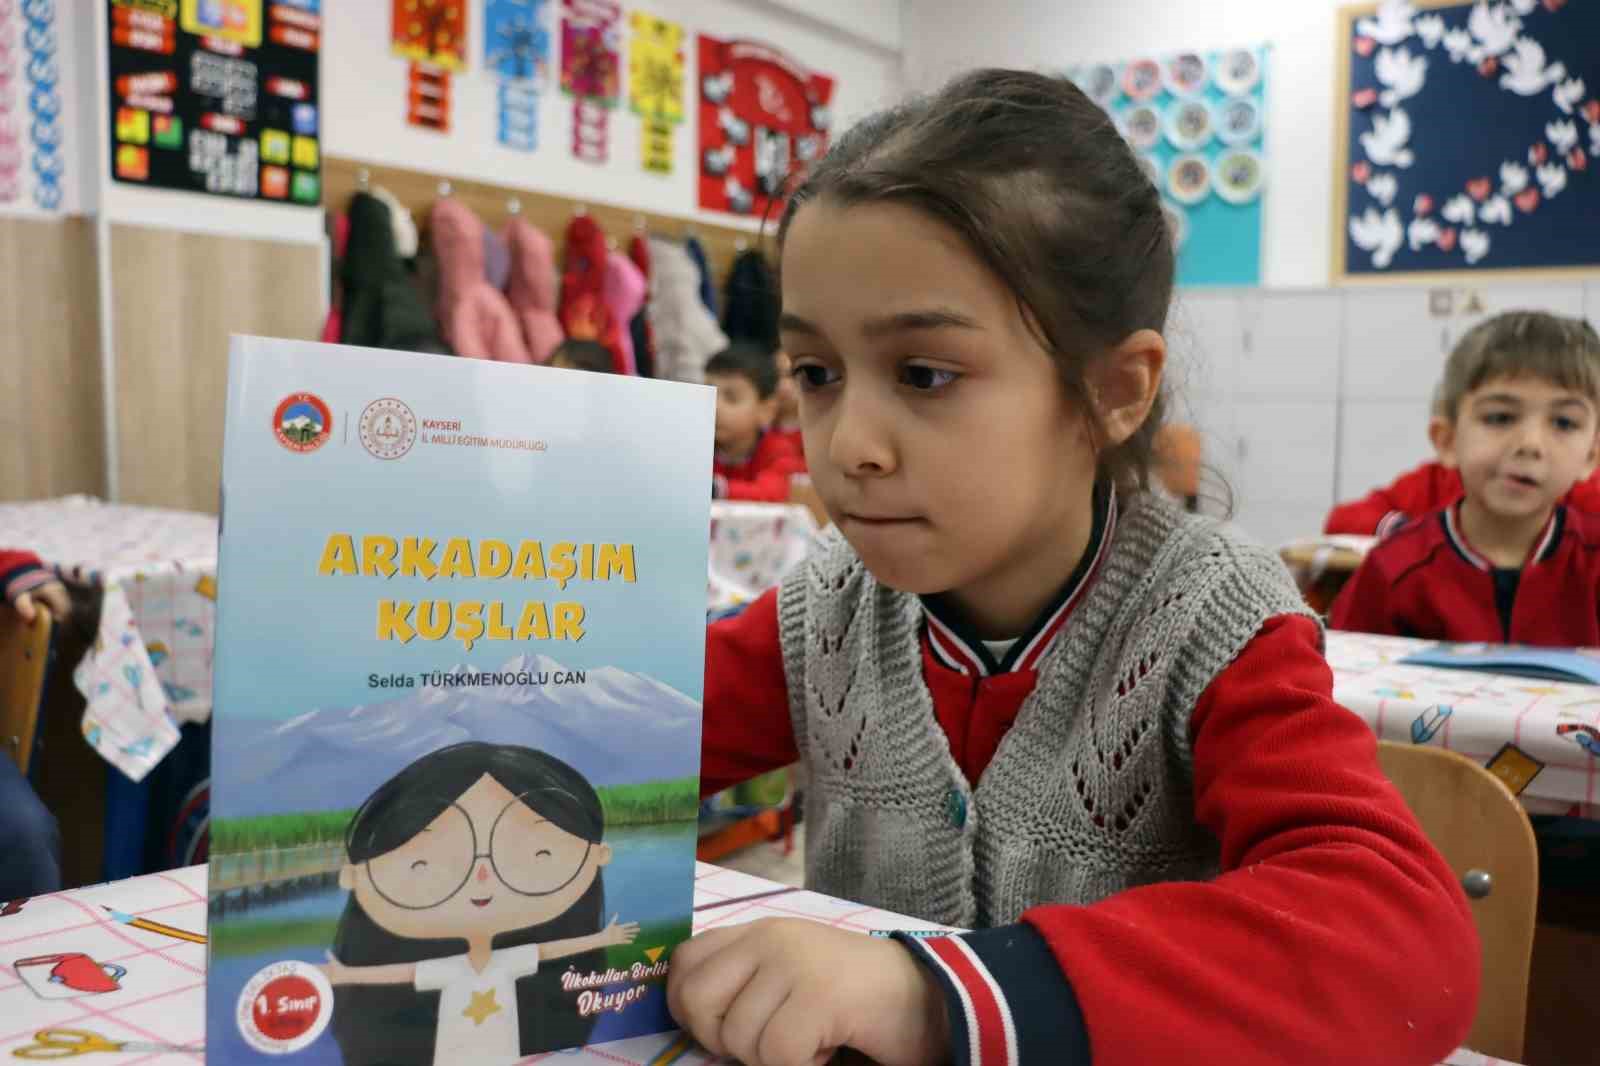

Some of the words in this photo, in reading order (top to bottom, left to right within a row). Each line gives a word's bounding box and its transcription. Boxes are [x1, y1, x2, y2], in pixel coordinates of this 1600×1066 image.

[422, 418, 461, 432] KAYSERİ
[318, 532, 638, 590] ARKADAŞIM
[376, 599, 586, 652] KUŞLAR
[368, 673, 415, 688] Selda
[420, 668, 549, 687] TÜRKMENOĞLU
[553, 671, 586, 686] CAN
[561, 965, 629, 991] İlkokullar
[277, 994, 318, 1015] Sınıf
[577, 983, 647, 1017] Okuyor
